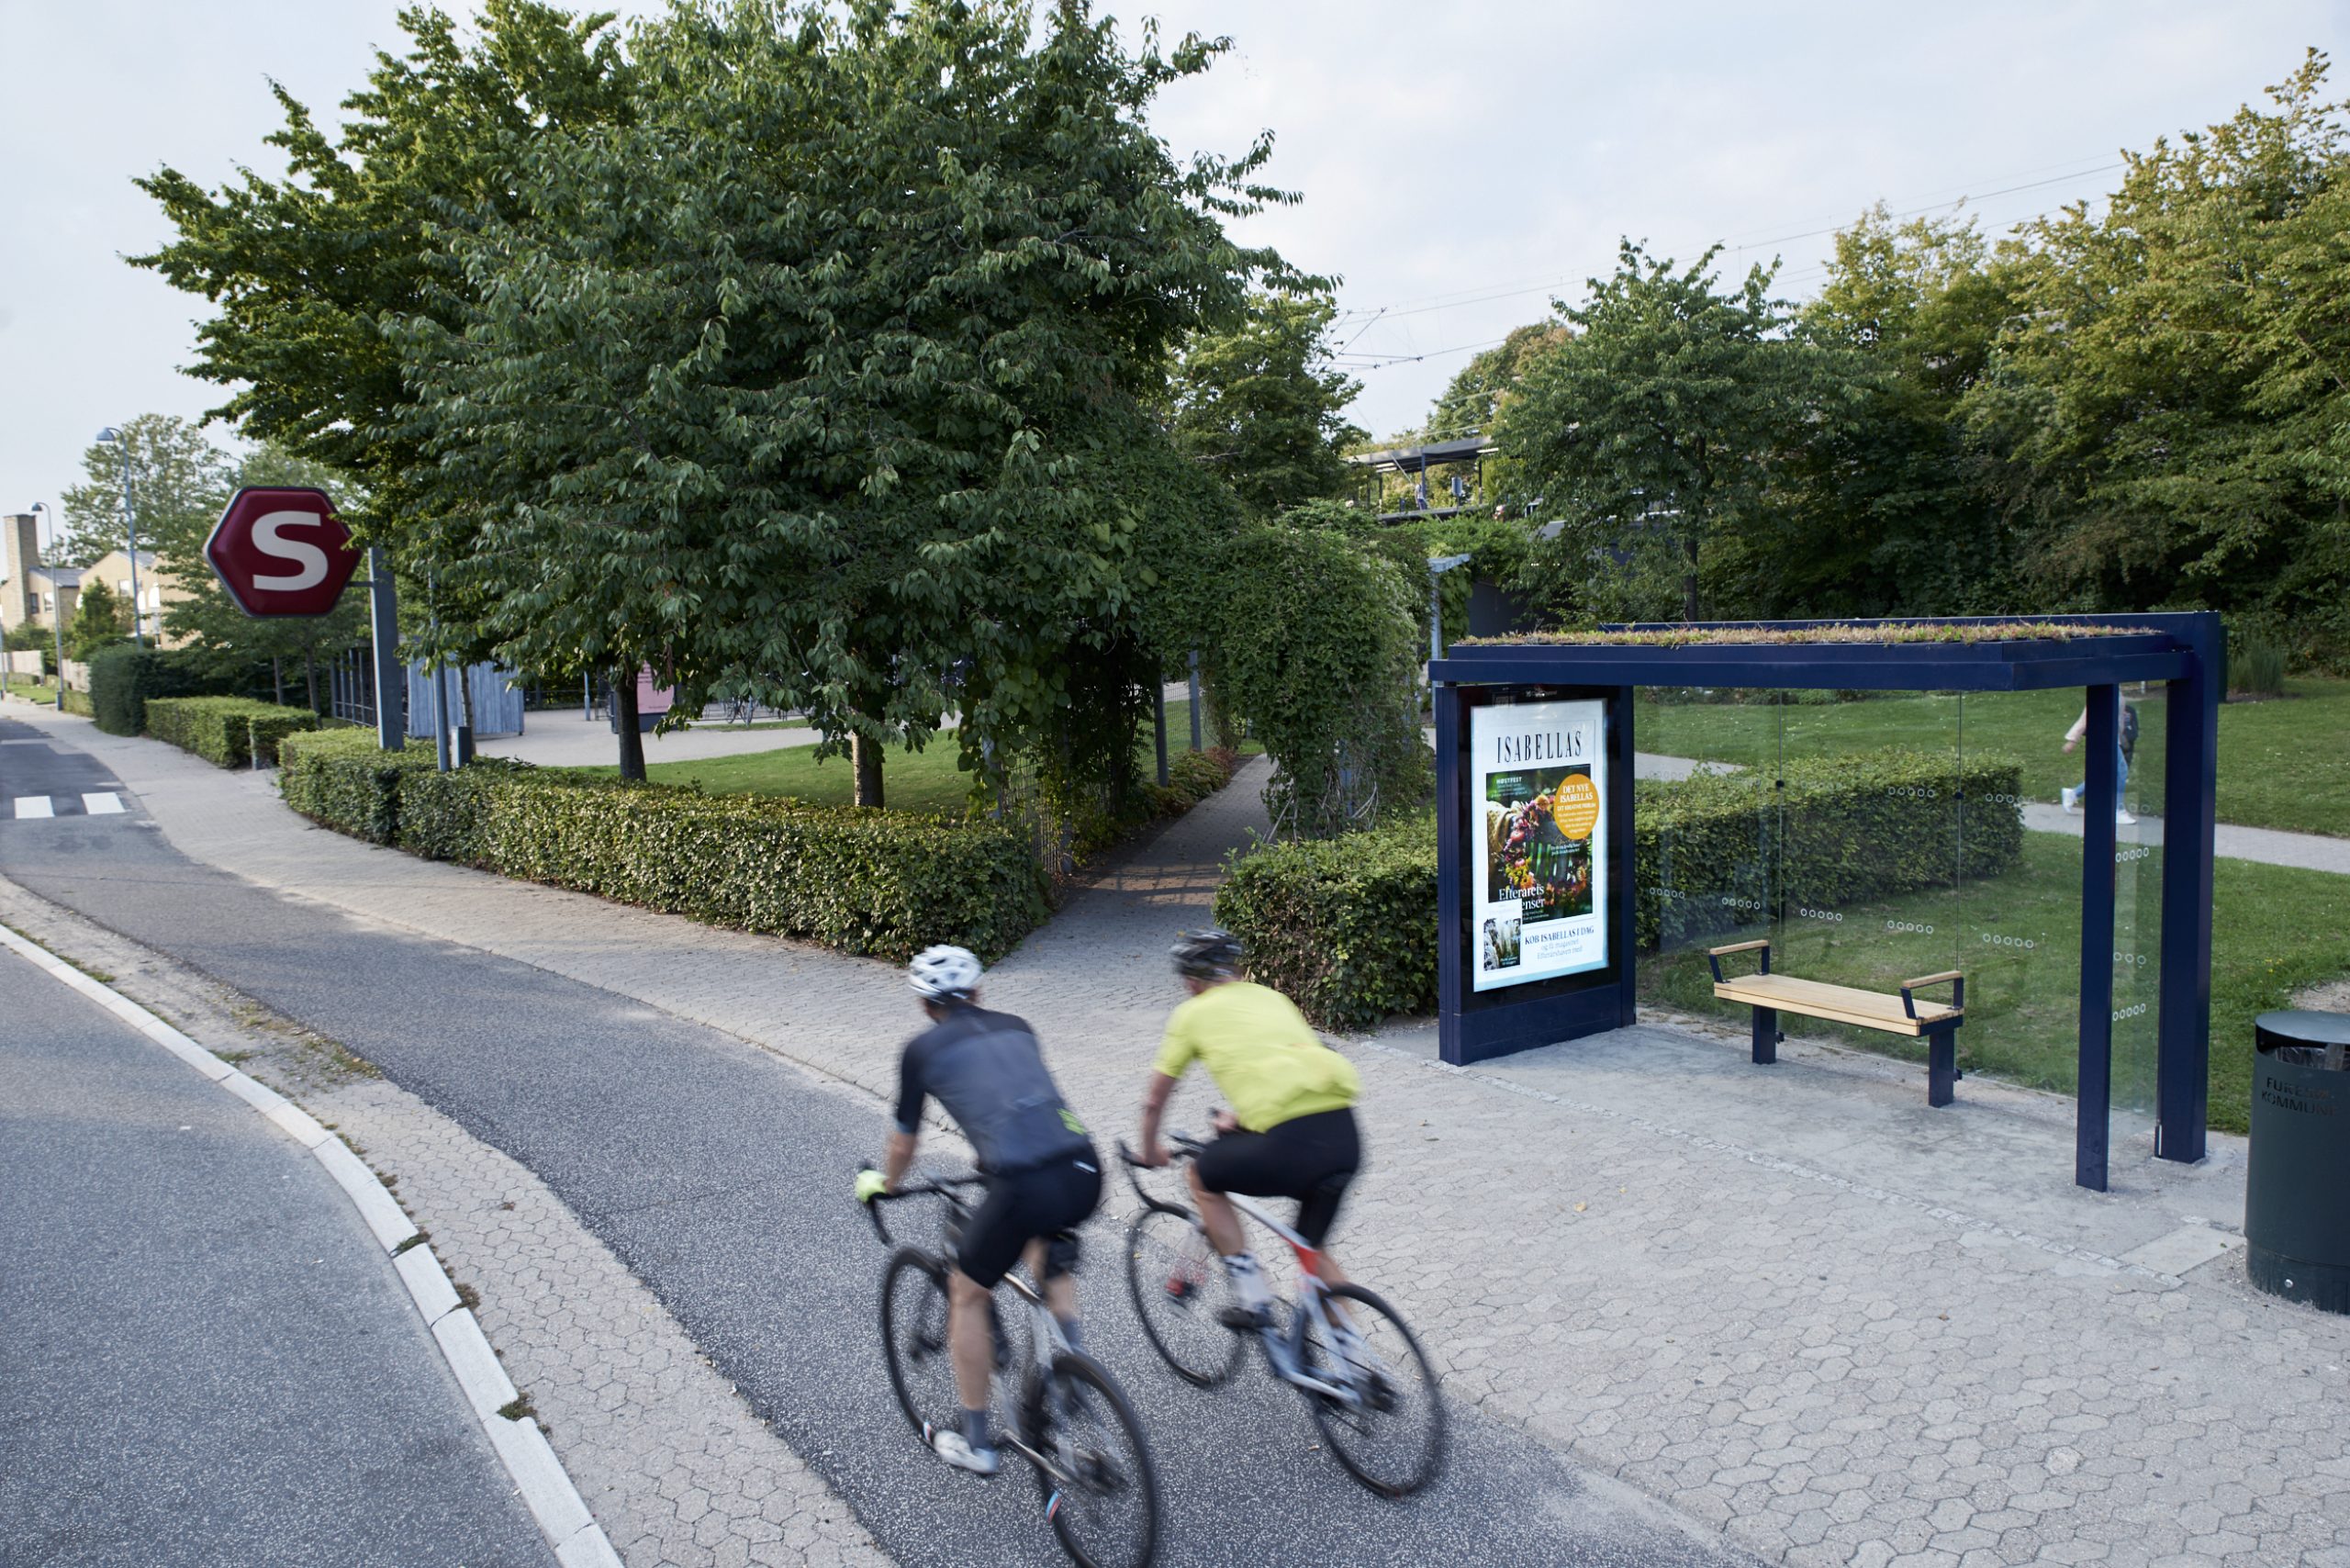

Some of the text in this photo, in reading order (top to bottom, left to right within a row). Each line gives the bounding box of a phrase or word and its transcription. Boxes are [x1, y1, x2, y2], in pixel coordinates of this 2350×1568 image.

[252, 510, 329, 591] S
[1497, 731, 1581, 763] ISABELLAS
[1561, 792, 1593, 803] ISABELLAS
[1563, 785, 1575, 794] DET
[1540, 928, 1576, 943] ISABELLAS
[1581, 925, 1595, 935] DAG
